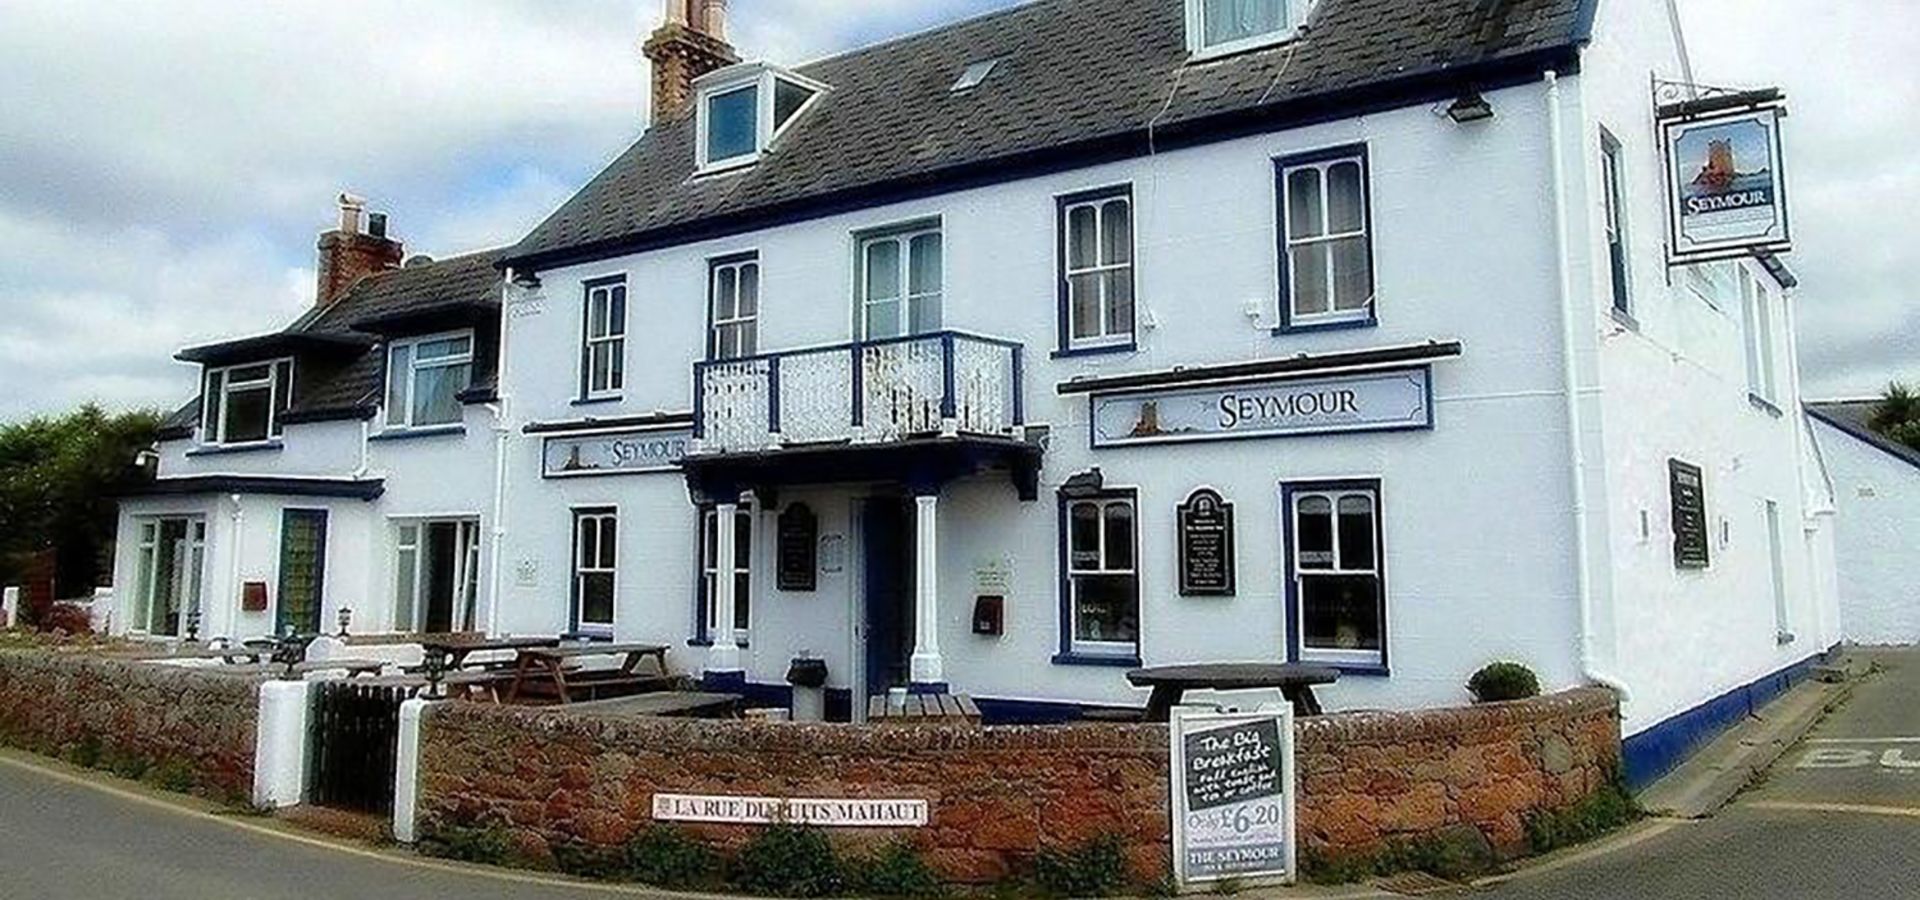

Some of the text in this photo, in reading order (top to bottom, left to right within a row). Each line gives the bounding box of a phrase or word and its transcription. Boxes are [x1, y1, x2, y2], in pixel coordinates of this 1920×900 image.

[1687, 190, 1766, 215] SEYMOUR
[1219, 390, 1357, 428] SEYMOUR
[613, 440, 687, 466] SEYMOUR
[675, 799, 698, 816] LA
[704, 800, 738, 818] RUE
[833, 802, 921, 822] MAHAUT
